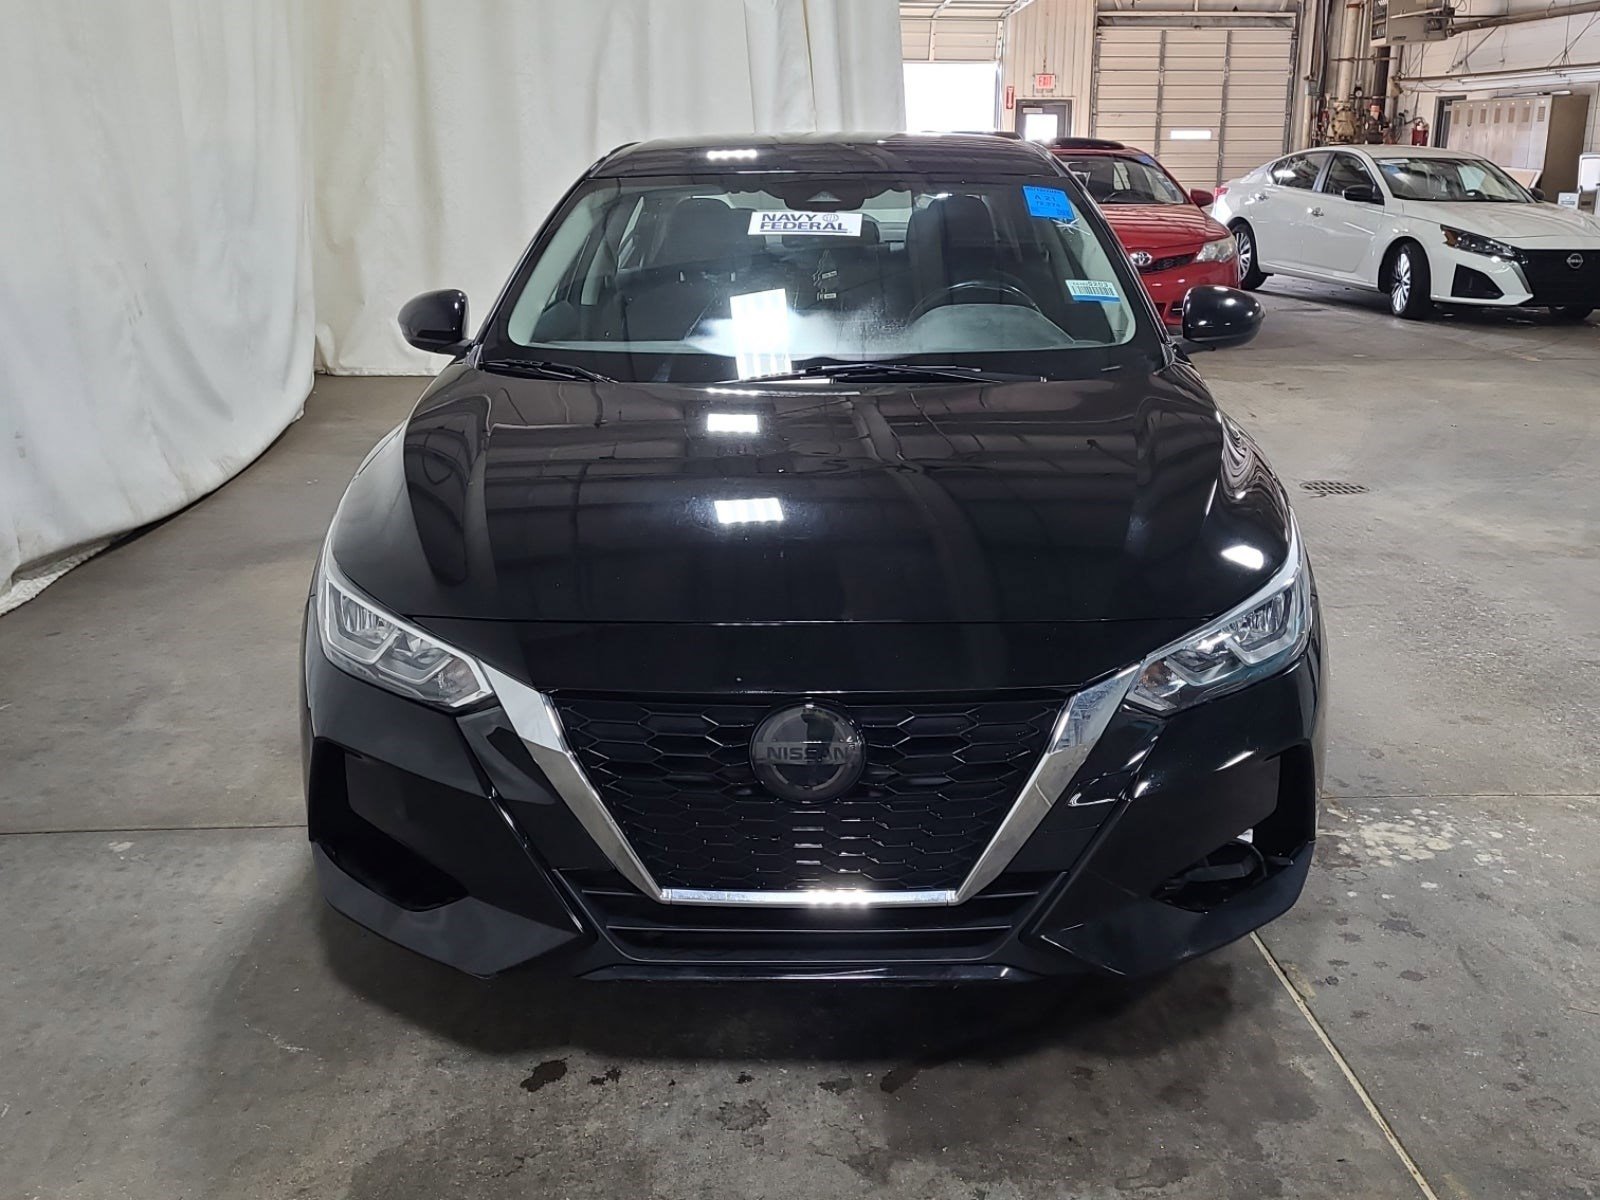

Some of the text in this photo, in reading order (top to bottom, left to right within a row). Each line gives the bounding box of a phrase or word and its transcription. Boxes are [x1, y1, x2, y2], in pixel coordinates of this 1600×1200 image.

[762, 213, 817, 221] NAVY
[760, 221, 848, 230] FEDERAL
[767, 746, 848, 761] NISSAN
